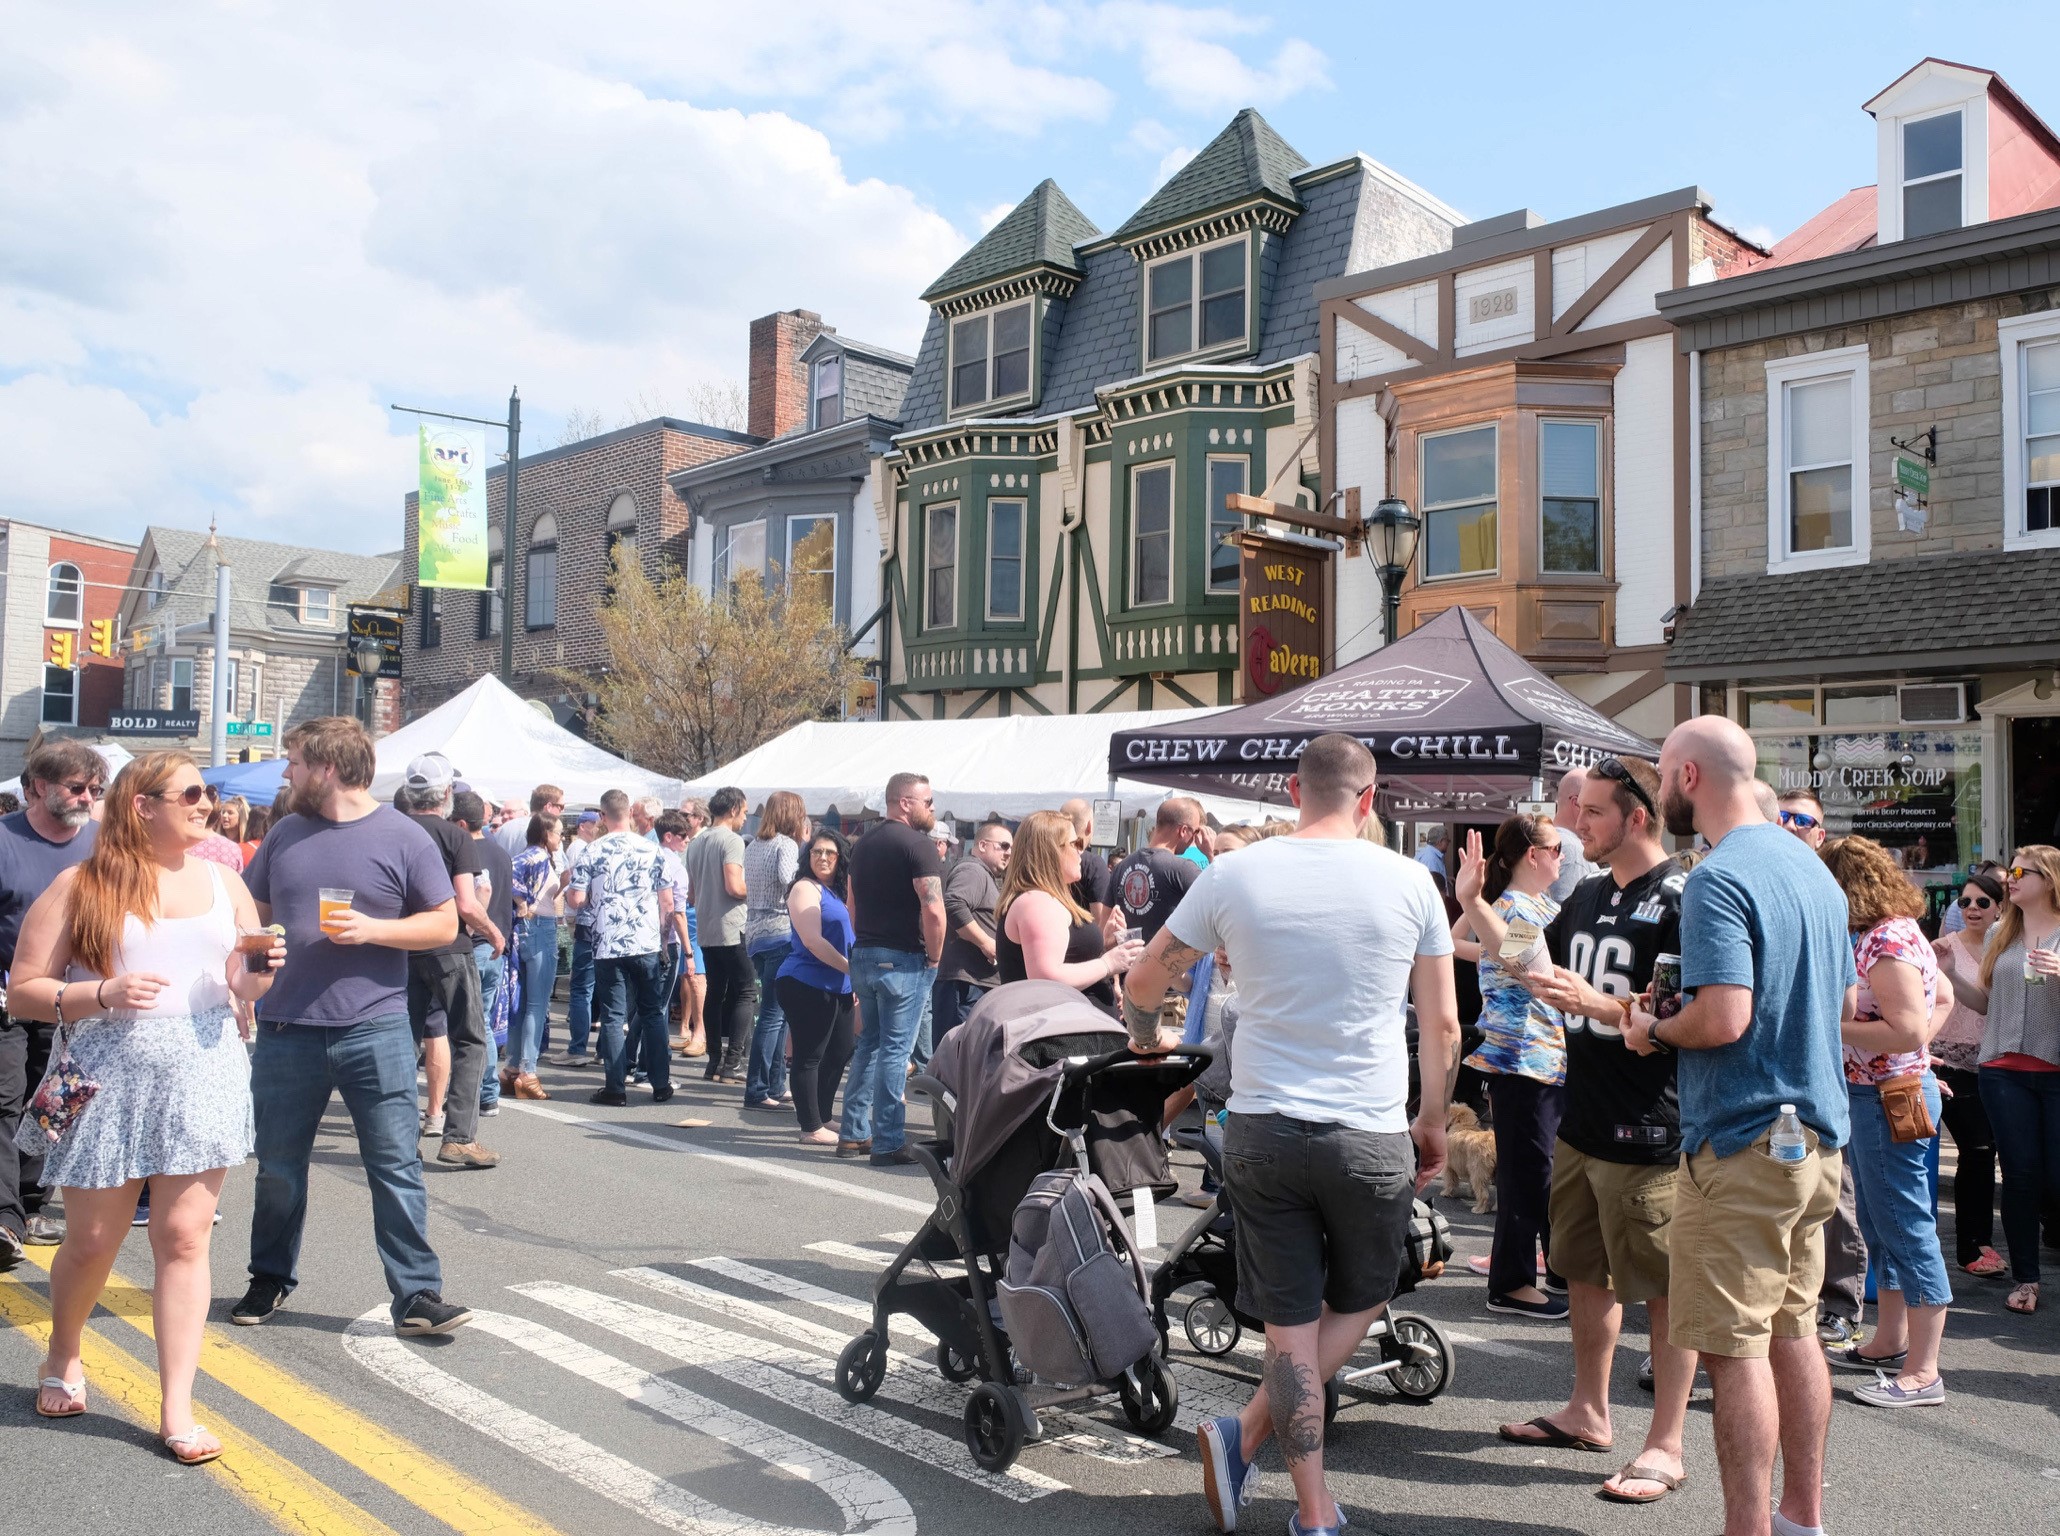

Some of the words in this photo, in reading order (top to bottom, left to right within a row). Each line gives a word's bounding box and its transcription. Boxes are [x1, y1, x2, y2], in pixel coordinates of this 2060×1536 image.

[1473, 293, 1514, 318] 1928
[433, 447, 469, 465] art
[434, 476, 451, 484] June
[424, 492, 445, 502] Fine
[447, 494, 467, 505] Arts
[447, 507, 477, 519] Crafts
[431, 519, 459, 530] Music
[452, 532, 479, 545] Food
[1263, 564, 1305, 586] WEST
[1250, 593, 1317, 624] READING
[1352, 679, 1405, 687] READING
[1302, 688, 1455, 703] CHATTY
[1290, 701, 1430, 714] MONKS
[110, 716, 157, 729] BOLD
[165, 719, 197, 728] REALTY
[1126, 738, 1228, 762] CHEW
[1390, 734, 1520, 761] CHILL
[1778, 767, 1837, 788] MUDDY
[1839, 766, 1896, 788] CREEK
[1900, 765, 1947, 787] SOAP
[1818, 789, 1902, 801] COMPANY
[1881, 808, 1899, 816] BODY
[1900, 808, 1936, 816] PRODUCTS
[1150, 890, 1160, 899] 17
[1509, 932, 1538, 940] ATIONAL
